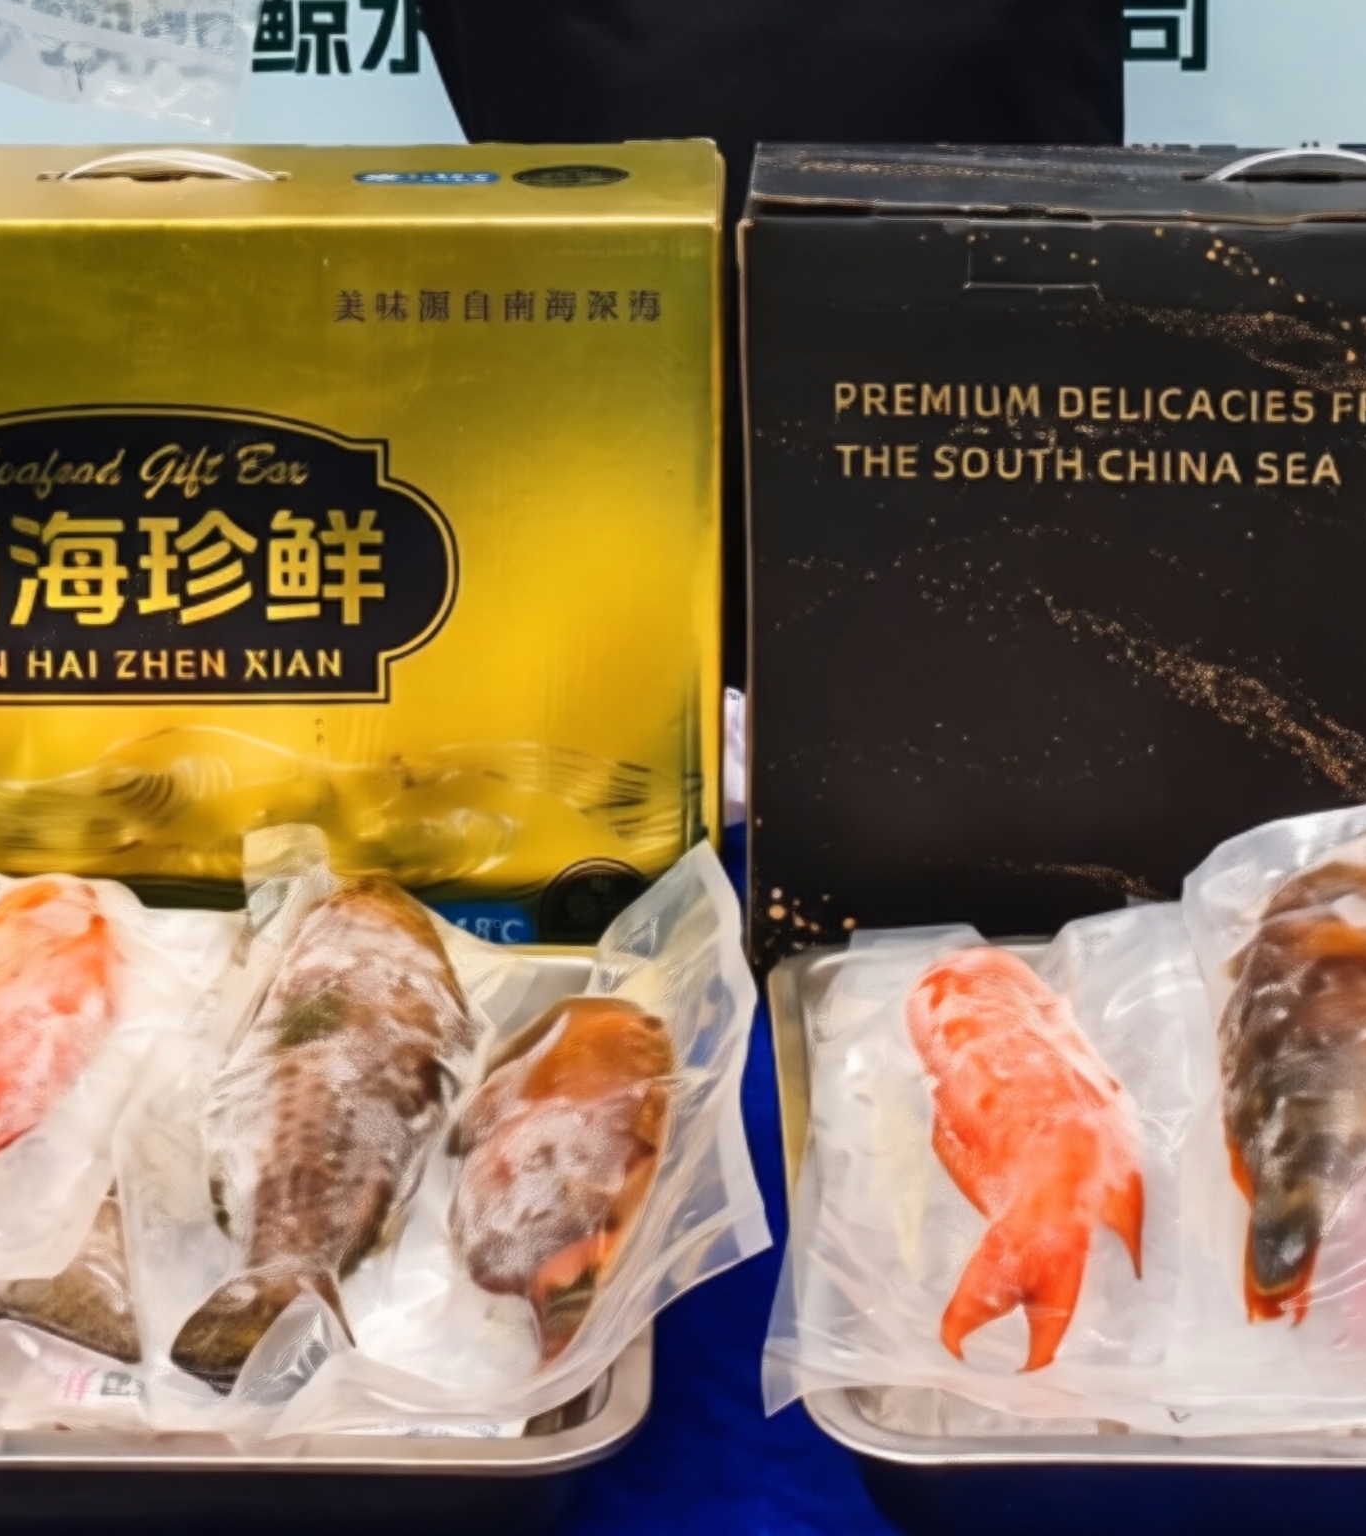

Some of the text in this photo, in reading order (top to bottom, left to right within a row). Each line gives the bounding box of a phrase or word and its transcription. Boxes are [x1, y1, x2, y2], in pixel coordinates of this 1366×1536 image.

[333, 288, 662, 324] 美味源自南海深海
[834, 382, 1038, 418] PREMIUM
[1057, 385, 1315, 423] DELICACIES
[137, 443, 221, 500] Gift
[235, 443, 311, 487] Box
[835, 444, 1342, 486] THE SOUTH CHINA SEA
[27, 649, 98, 680] HAI
[115, 649, 228, 680] ZHEN
[244, 649, 343, 680] XIAN
